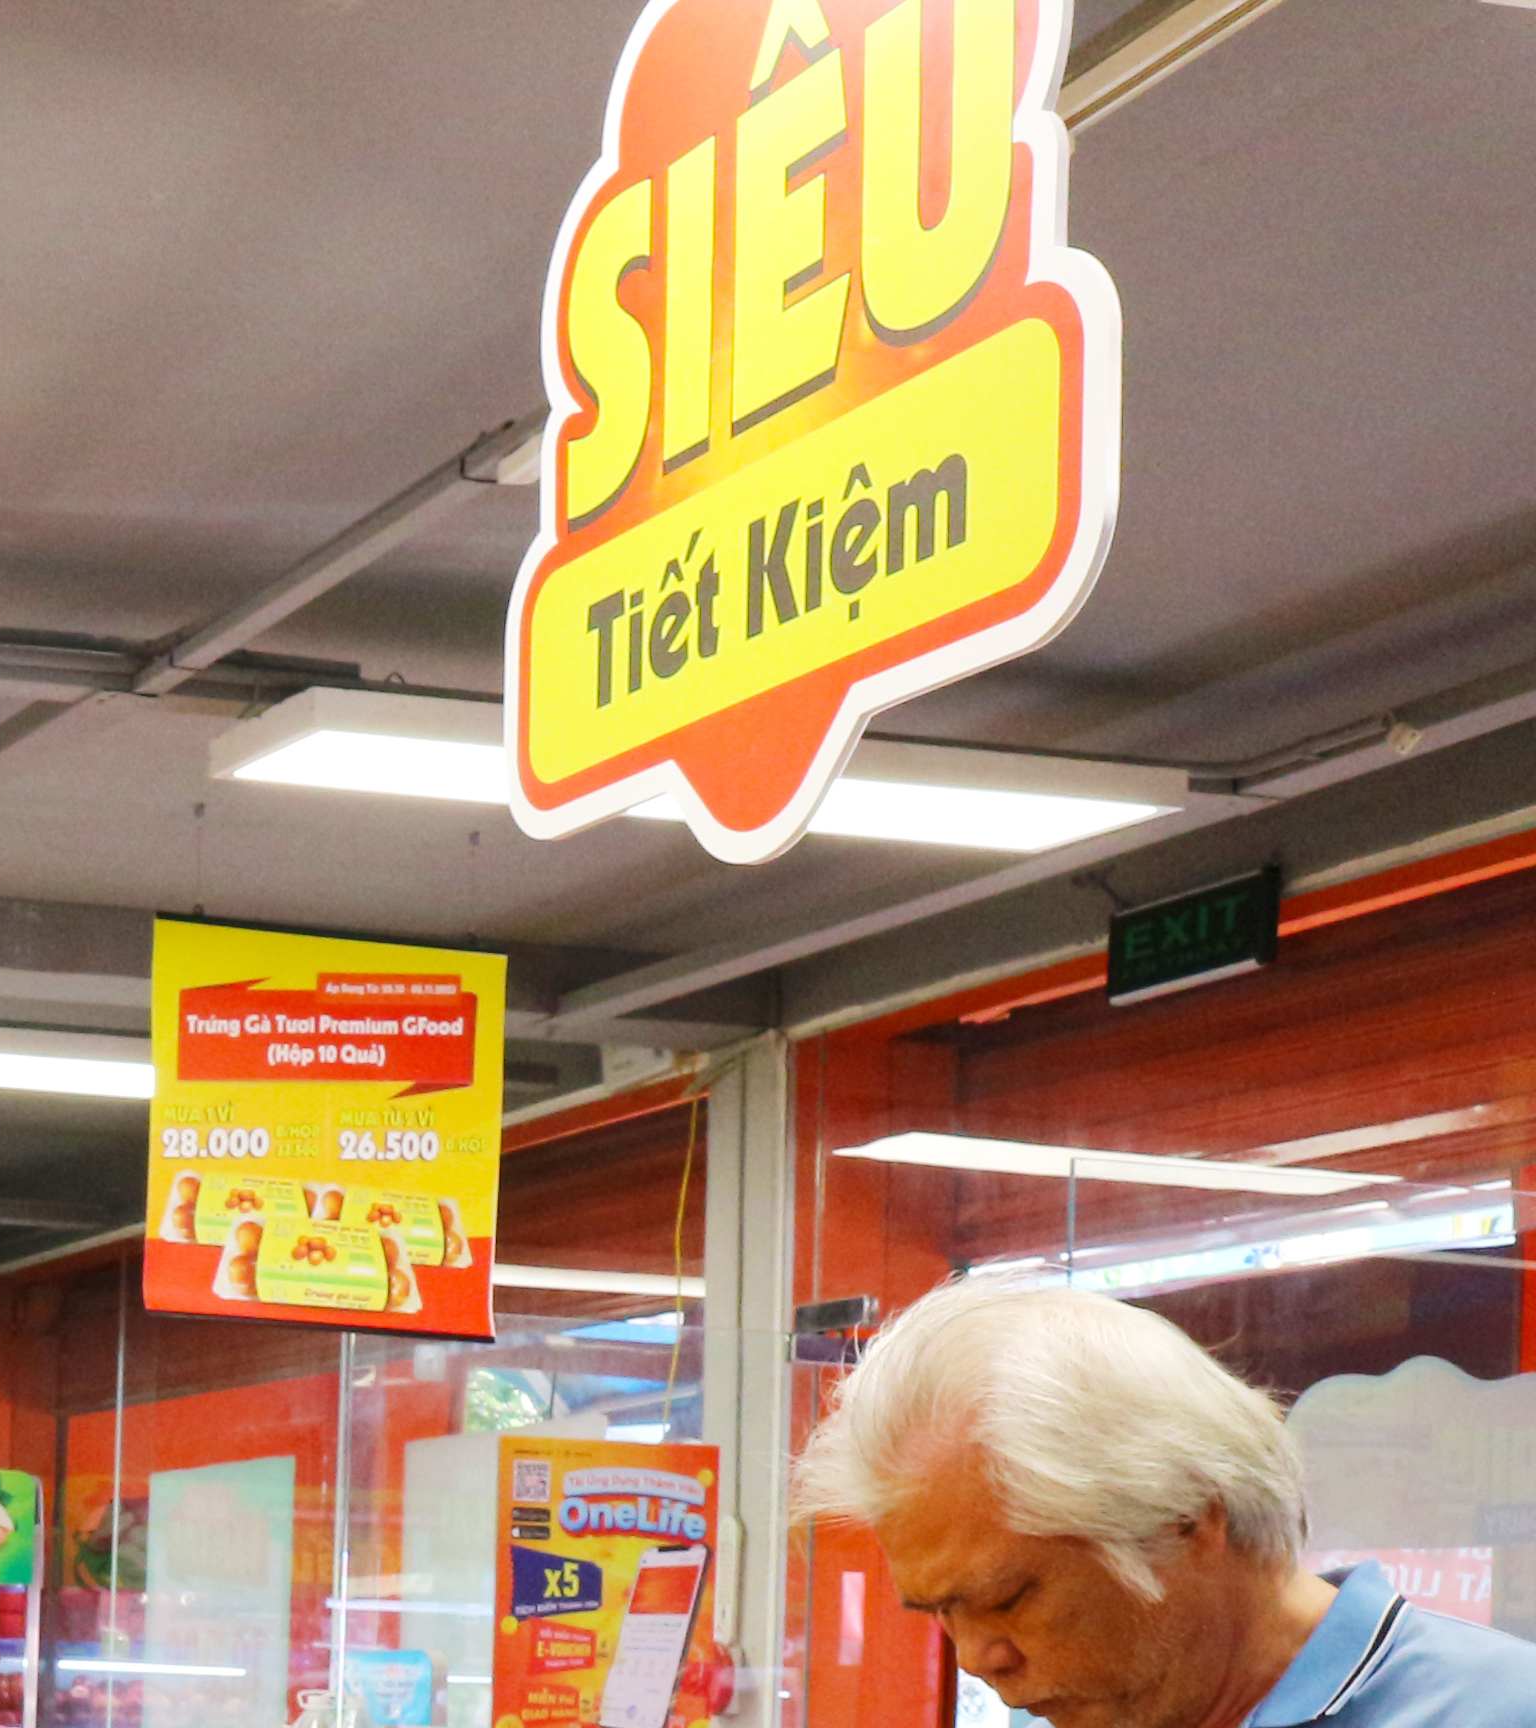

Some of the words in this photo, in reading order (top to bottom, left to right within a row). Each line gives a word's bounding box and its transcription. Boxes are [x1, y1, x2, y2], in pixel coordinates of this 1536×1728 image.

[565, 0, 1017, 534] SIÊU
[587, 527, 720, 710] Tiết
[746, 453, 969, 625] Kiệm
[1123, 893, 1248, 960] EXIT
[187, 1014, 241, 1038] Trứng
[244, 1014, 271, 1035] Gà
[319, 1016, 400, 1035] Premium
[402, 1016, 464, 1036] GFood
[268, 1043, 314, 1066] (Hộp
[317, 1045, 337, 1063] 10
[341, 1043, 386, 1067] Quả)
[162, 1106, 202, 1124] MUA
[339, 1109, 378, 1127] MUA
[161, 1126, 270, 1159] 28.000
[338, 1130, 440, 1161] 26.500
[559, 1495, 707, 1541] OneLife
[543, 1562, 580, 1598] x5
